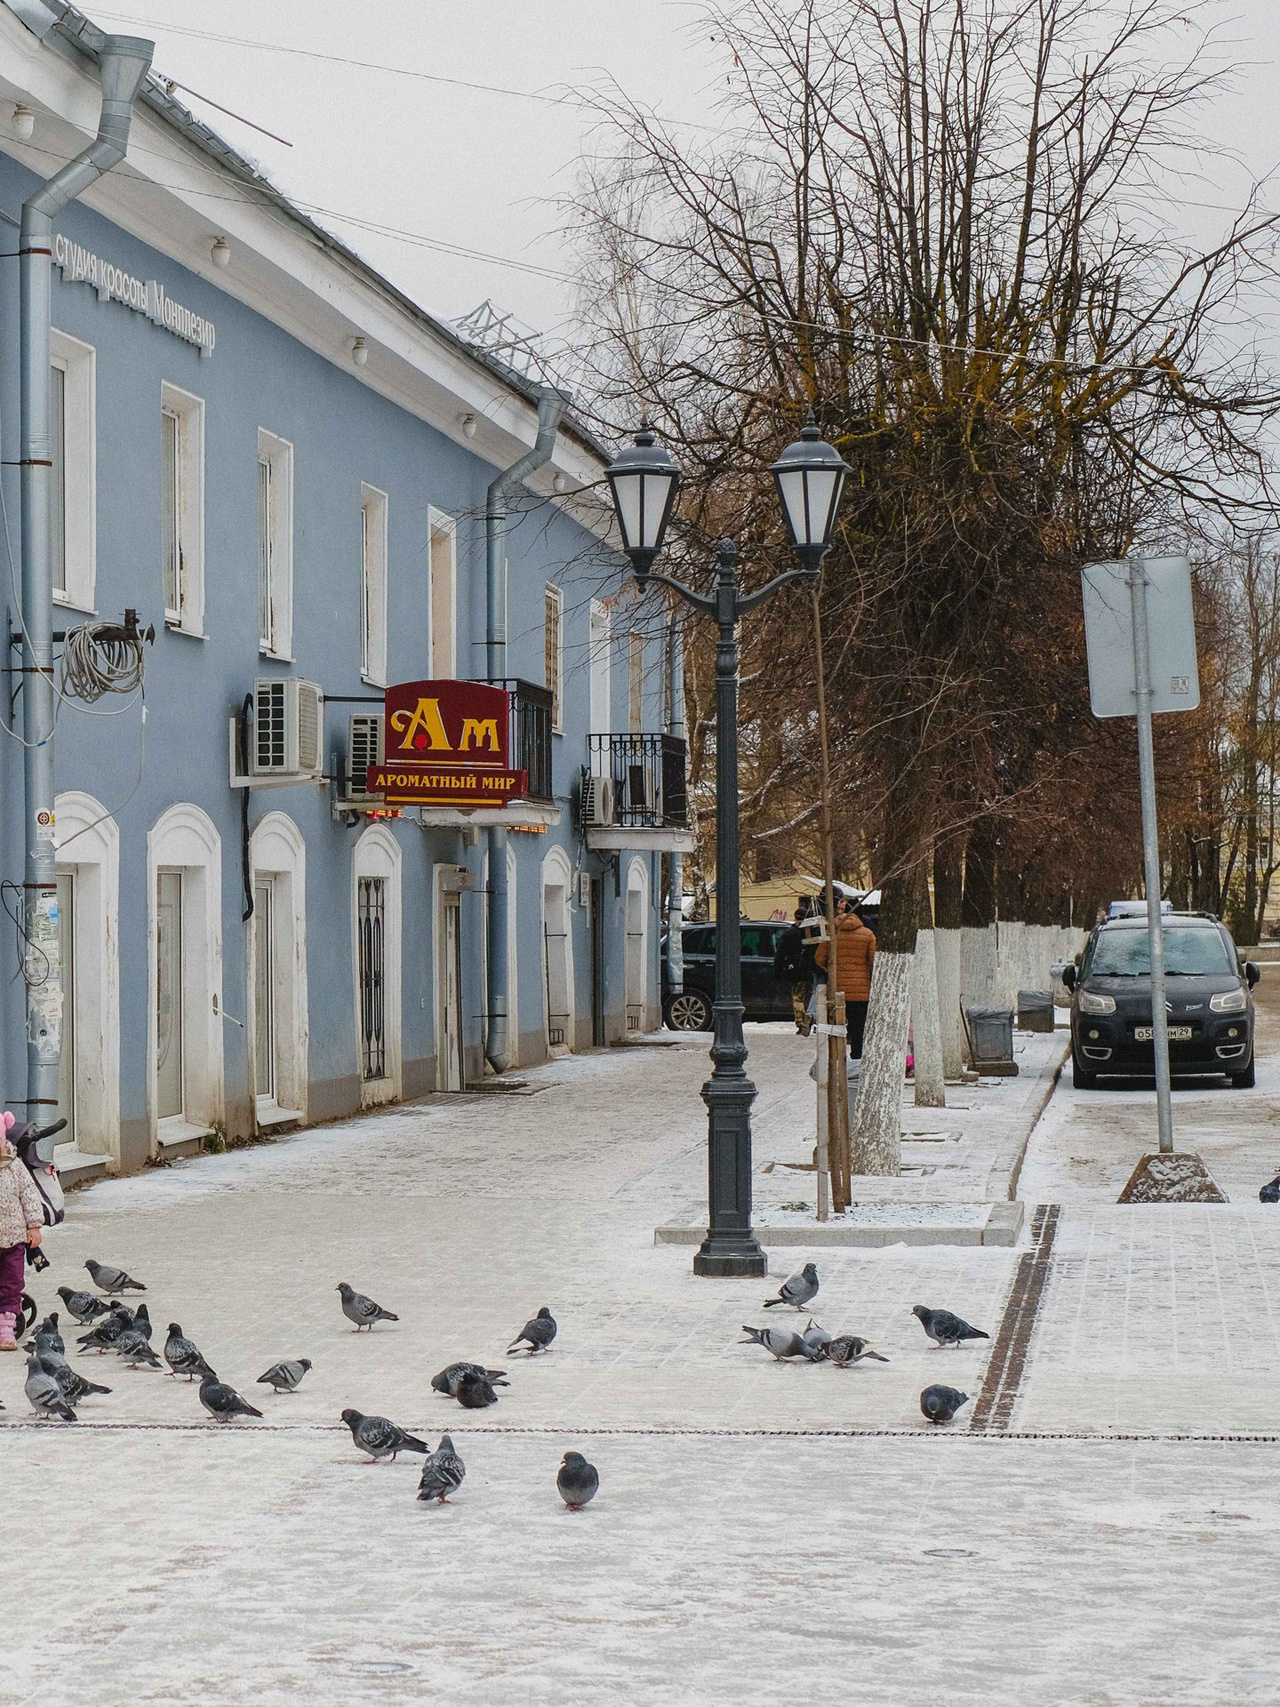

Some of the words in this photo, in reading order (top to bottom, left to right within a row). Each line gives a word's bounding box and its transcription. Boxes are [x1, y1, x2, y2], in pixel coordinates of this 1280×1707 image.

[100, 259, 148, 312] красоты
[154, 280, 215, 357] Монплезир
[375, 773, 477, 789] АРОМАТНЫЙ
[482, 776, 516, 790] МИР
[1179, 1028, 1189, 1036] 29
